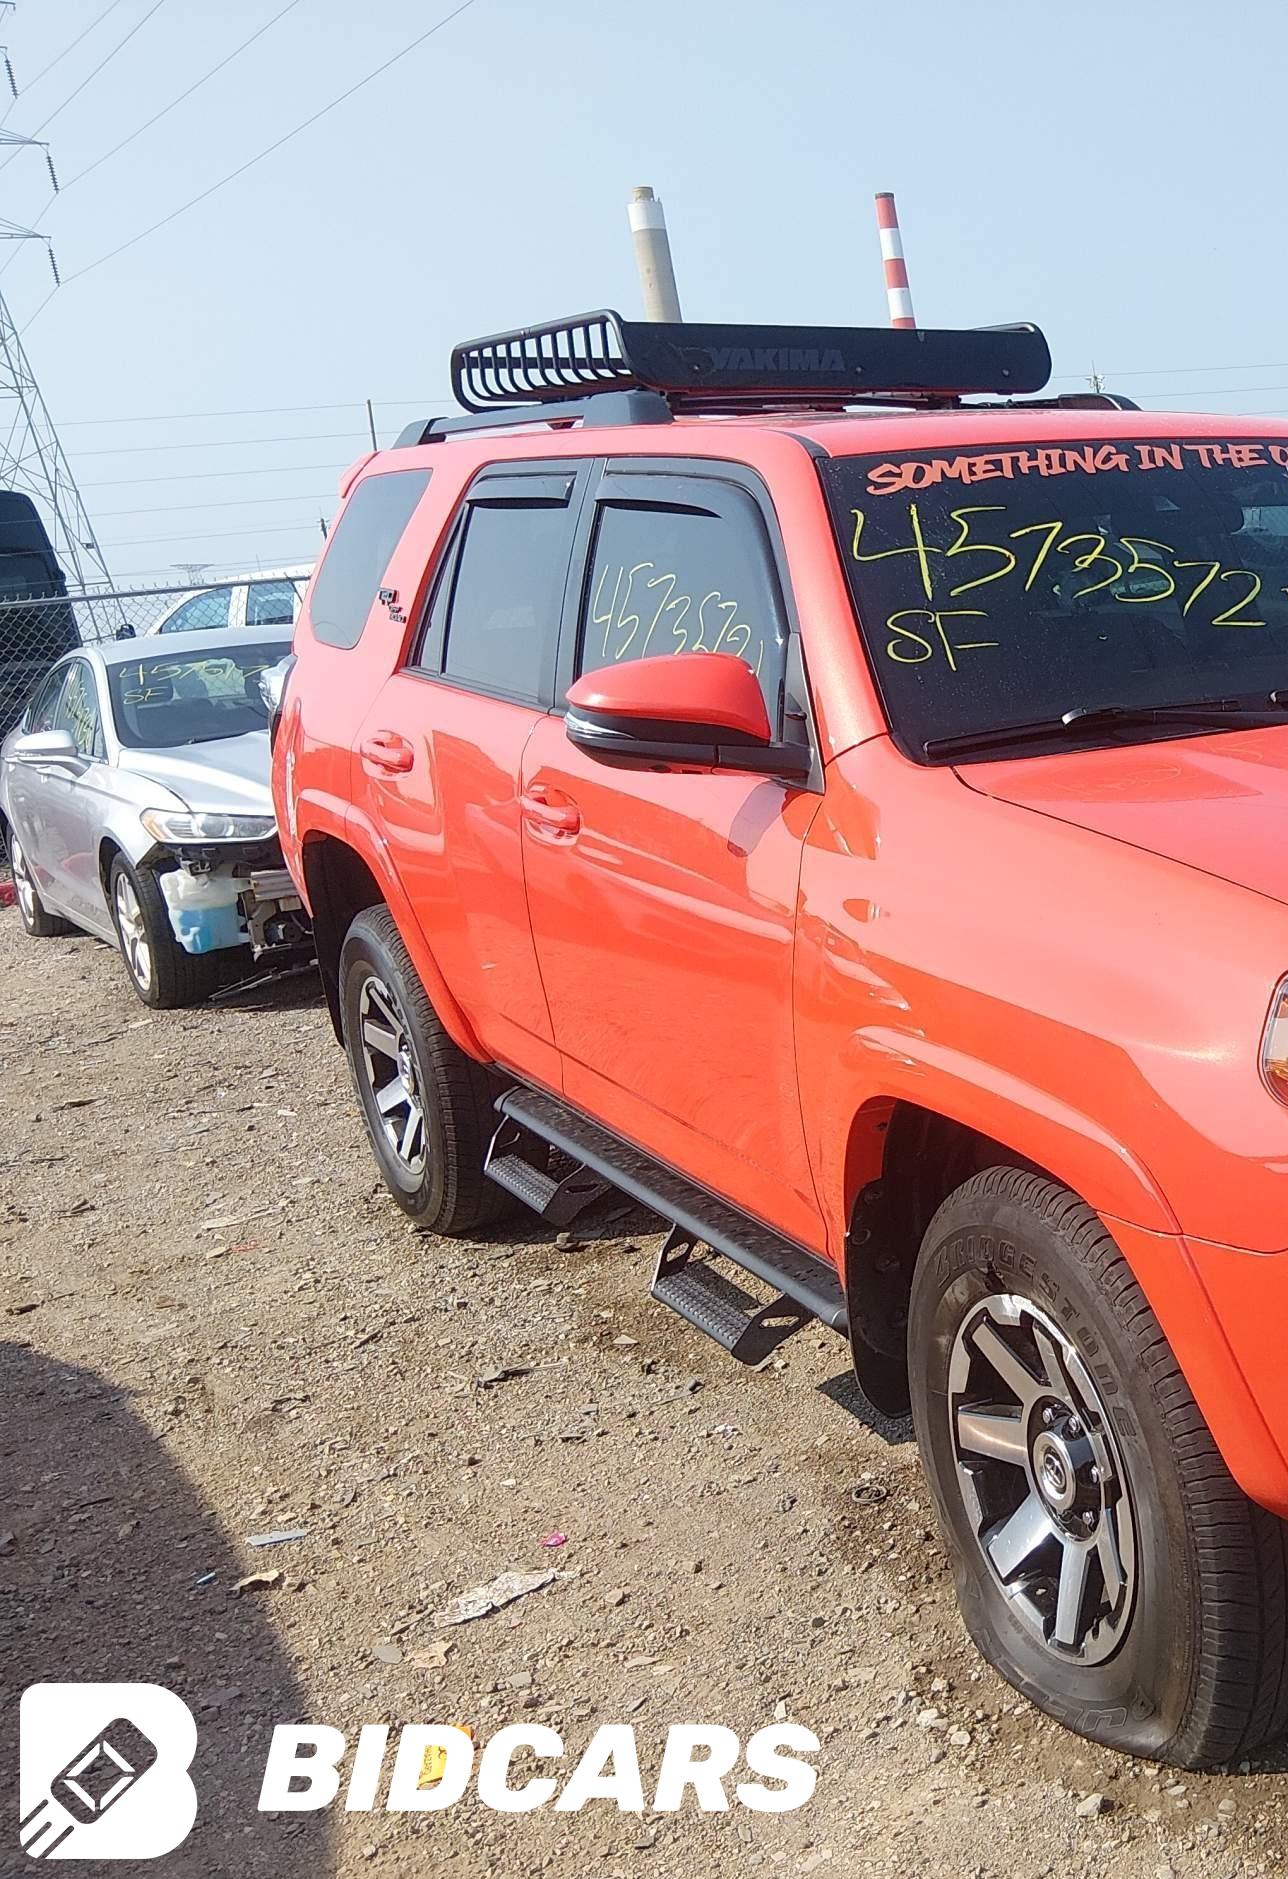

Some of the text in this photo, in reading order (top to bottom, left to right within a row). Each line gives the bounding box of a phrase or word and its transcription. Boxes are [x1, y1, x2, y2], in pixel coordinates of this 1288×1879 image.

[709, 348, 846, 371] YAKIMA
[866, 445, 1130, 496] SOMETHING
[1134, 444, 1185, 470] IN
[1183, 444, 1269, 468] THE
[886, 609, 1000, 671] SF
[936, 1234, 1138, 1438] BRIDGESTONE
